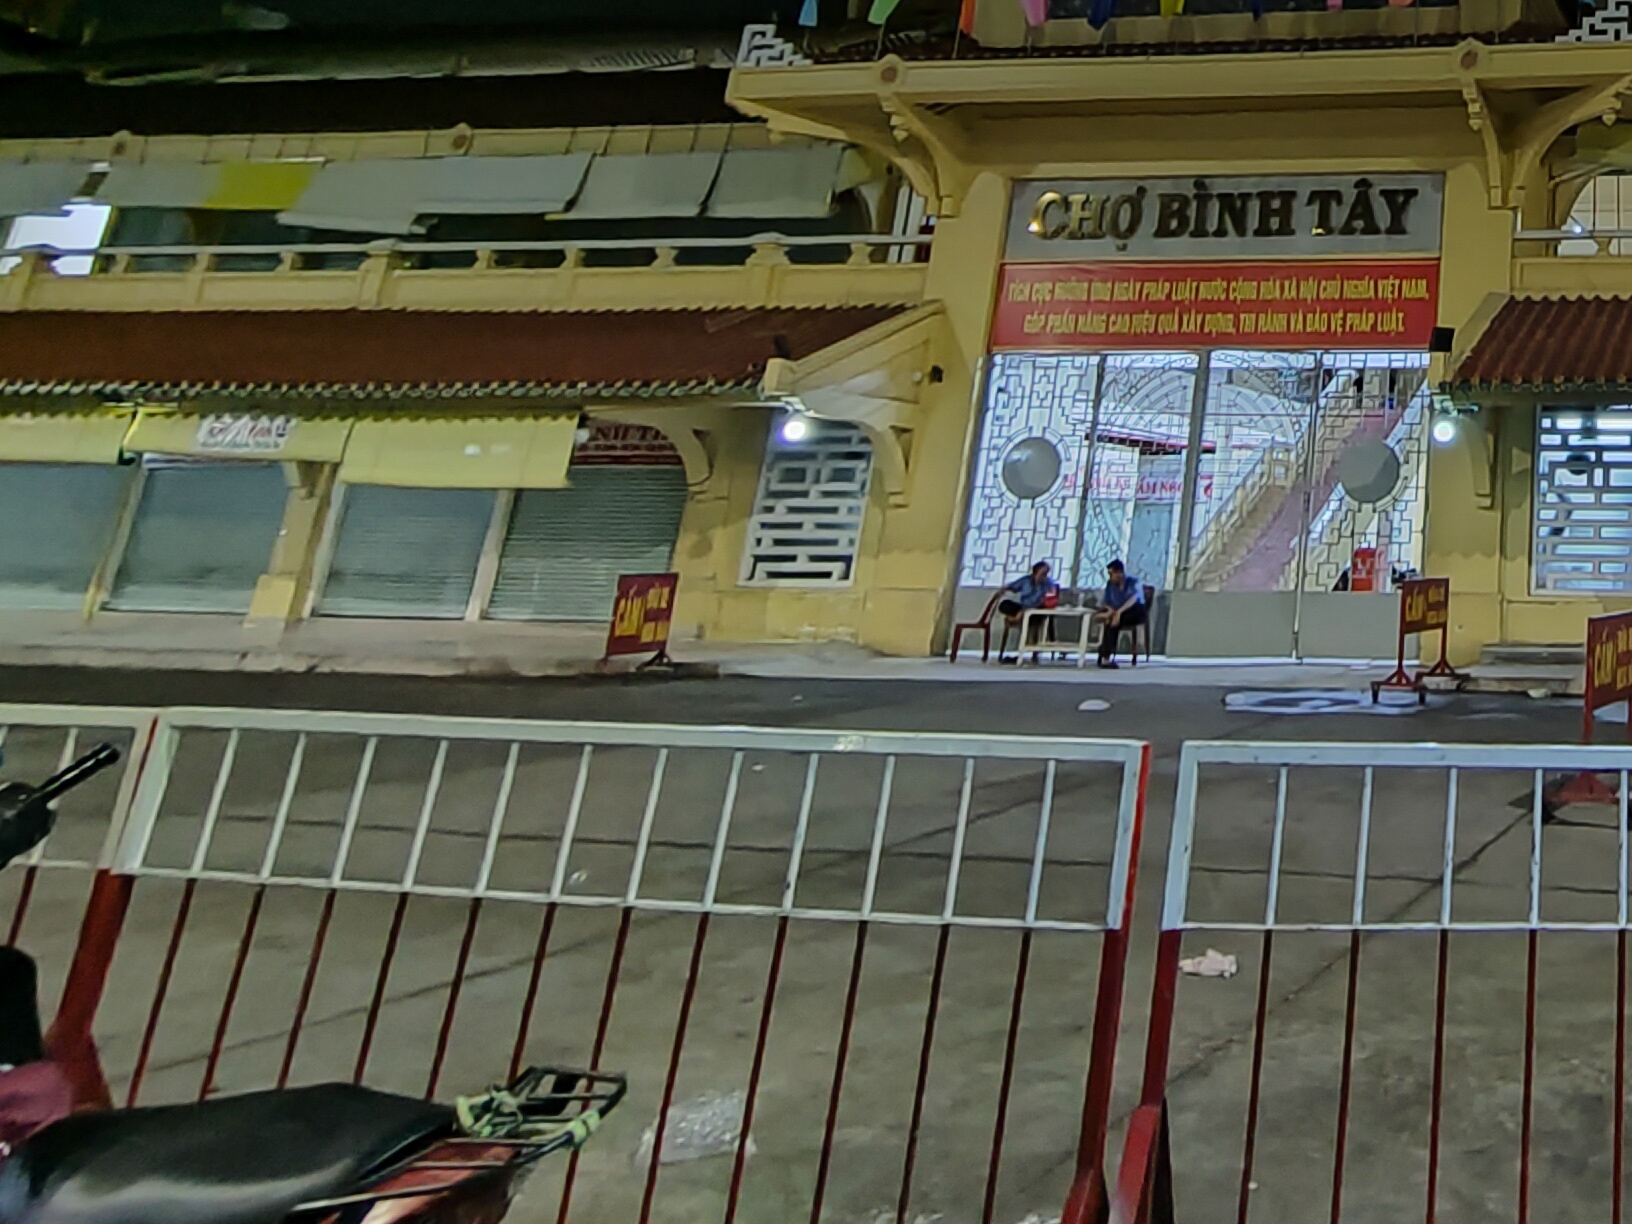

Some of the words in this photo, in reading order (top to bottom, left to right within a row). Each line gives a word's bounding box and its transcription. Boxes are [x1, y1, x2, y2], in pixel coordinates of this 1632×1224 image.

[1028, 185, 1148, 252] CHỢ
[1153, 178, 1297, 238] BÌNH
[1305, 178, 1419, 236] TÂY
[1345, 308, 1375, 333] PHÁP
